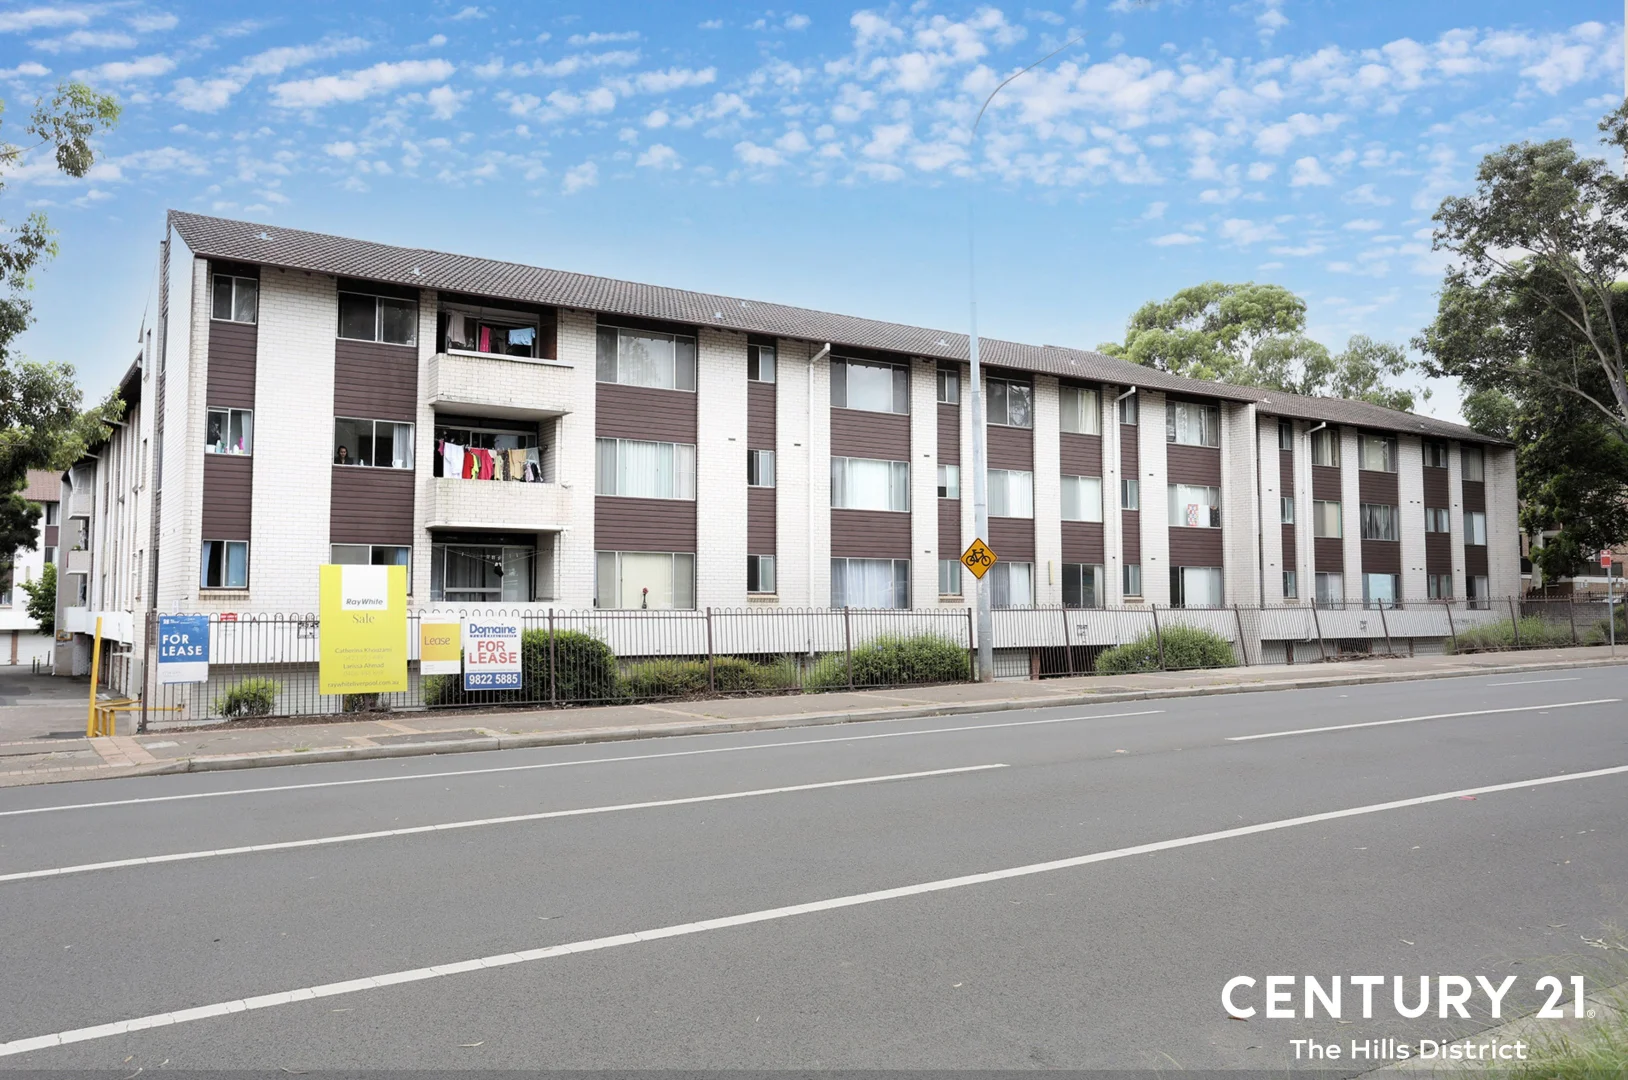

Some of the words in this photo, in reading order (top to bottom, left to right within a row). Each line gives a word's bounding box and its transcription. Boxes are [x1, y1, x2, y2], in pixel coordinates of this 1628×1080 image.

[352, 613, 375, 624] Sale
[469, 623, 517, 636] Domaine
[162, 634, 189, 645] FOR
[424, 636, 451, 646] Lease
[162, 645, 203, 657] LEASE
[477, 640, 506, 652] FOR
[468, 652, 518, 664] LEASE
[469, 674, 493, 685] 9822
[495, 673, 518, 684] 5885
